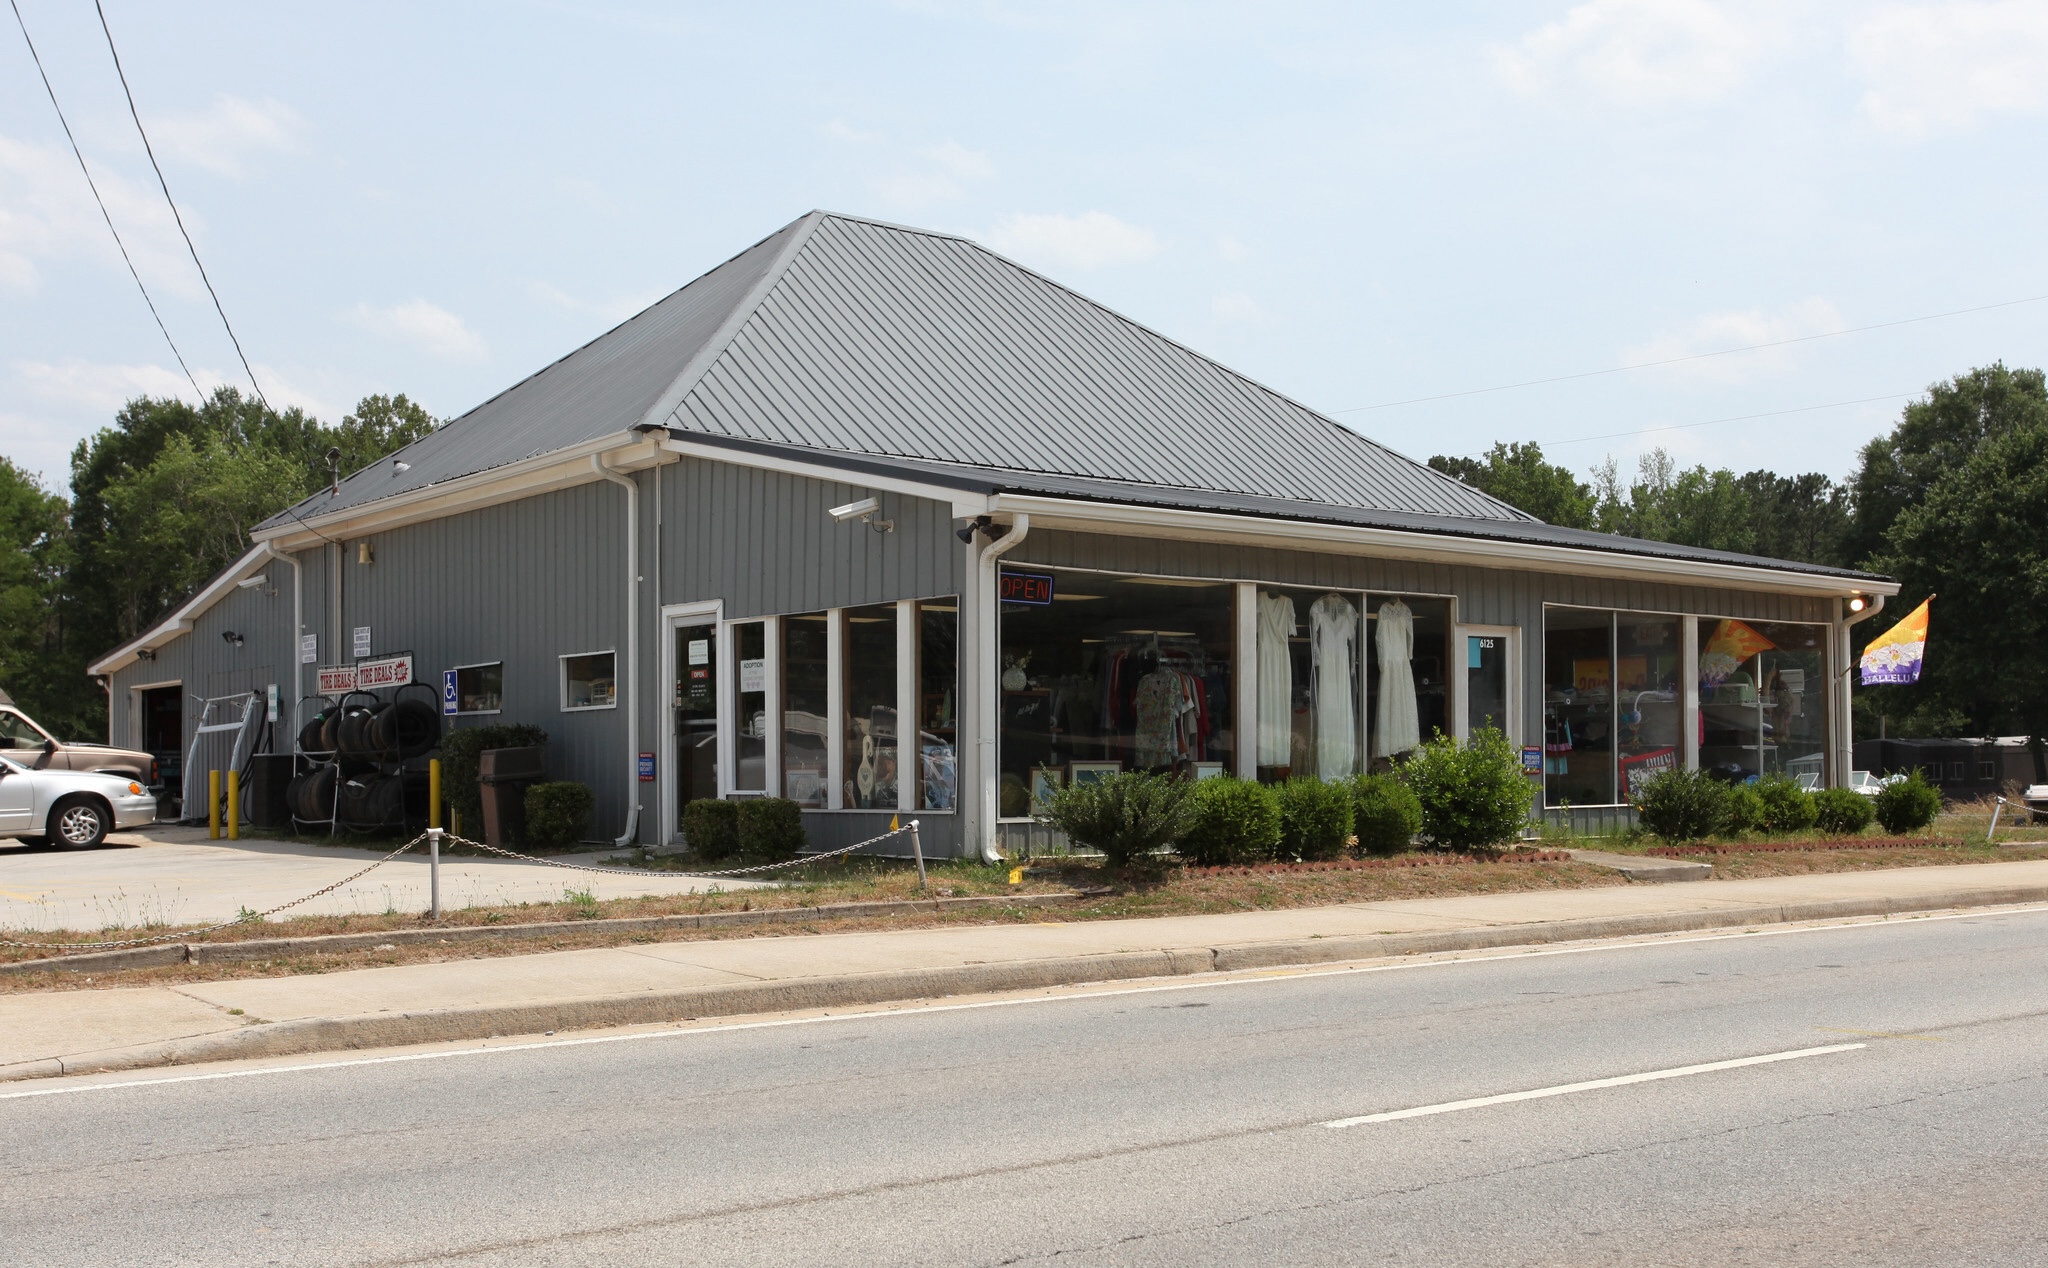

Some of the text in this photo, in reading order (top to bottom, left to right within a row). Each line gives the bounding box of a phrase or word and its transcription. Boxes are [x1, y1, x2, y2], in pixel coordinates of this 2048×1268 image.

[1000, 577, 1049, 600] OPEN
[1480, 638, 1494, 648] 6125
[743, 661, 764, 669] ADOPTION
[320, 673, 352, 689] TIRE DEALS
[360, 668, 373, 684] TIRE
[374, 665, 393, 682] DEALS
